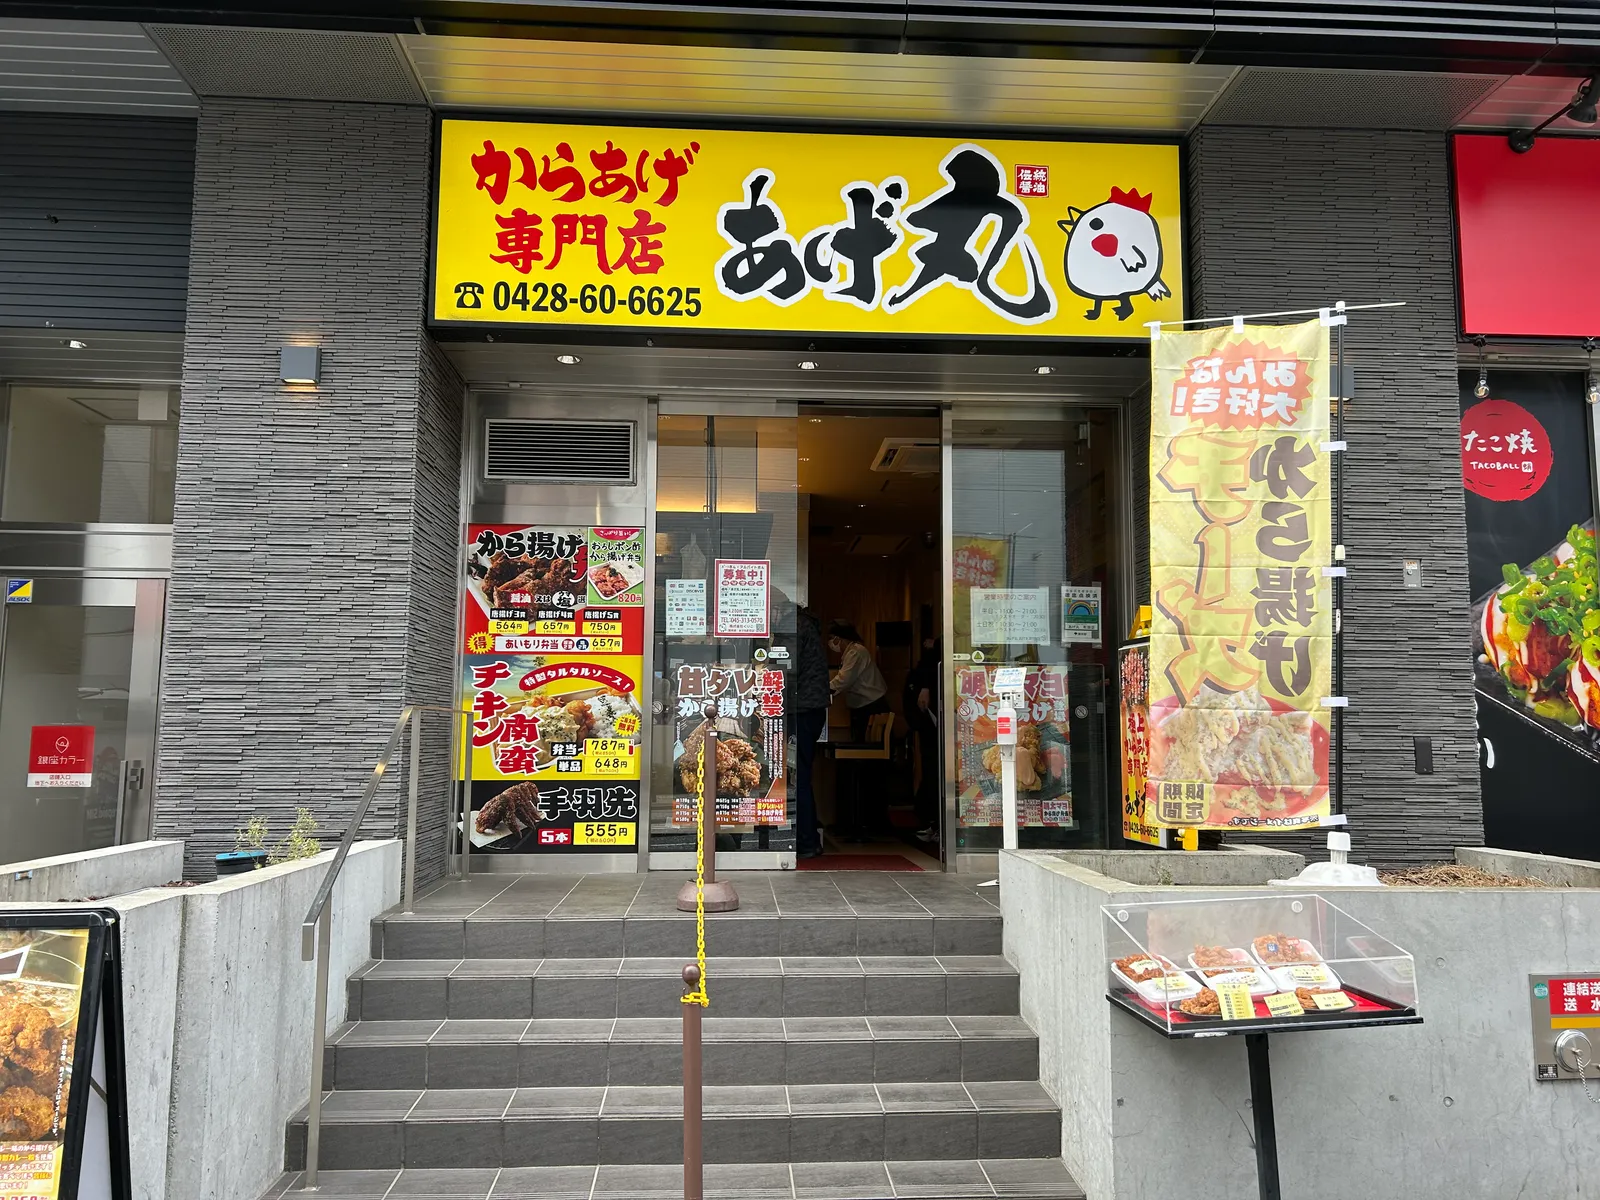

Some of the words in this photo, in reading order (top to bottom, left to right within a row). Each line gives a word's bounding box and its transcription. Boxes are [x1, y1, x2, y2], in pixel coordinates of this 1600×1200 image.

[471, 139, 700, 207] からあげ
[1018, 168, 1046, 182] 伝統
[1019, 181, 1046, 193] 醤油
[717, 145, 1056, 324] あげ丸
[489, 208, 667, 274] 専門店
[493, 281, 701, 316] 0428-60-6625
[1463, 428, 1538, 455] たこ焼
[1470, 461, 1520, 471] TACOBALL
[477, 530, 585, 560] から揚げ
[591, 541, 641, 551] おろしポン酢
[589, 551, 641, 562] から揚げ弁当
[723, 569, 763, 580] 募集中!
[618, 593, 642, 603] 820円
[496, 621, 523, 630] 564円
[542, 621, 570, 631] 657円
[589, 622, 616, 631] 750円
[473, 636, 488, 650] 得
[505, 639, 559, 650] あいもり弁当
[592, 638, 620, 647] 657円
[524, 667, 631, 690] 特製タルタルソース!
[471, 661, 512, 747] チキン
[499, 713, 541, 776] 南蛮
[552, 743, 577, 755] 弁当
[591, 740, 625, 750] 787円
[37, 755, 85, 765] 銀座カラー
[558, 760, 581, 772] 単品
[595, 758, 628, 768] 648円
[1127, 757, 1148, 777] 専門店
[537, 786, 637, 821] 手羽先
[585, 824, 628, 837] 555円
[541, 831, 569, 843] 5本
